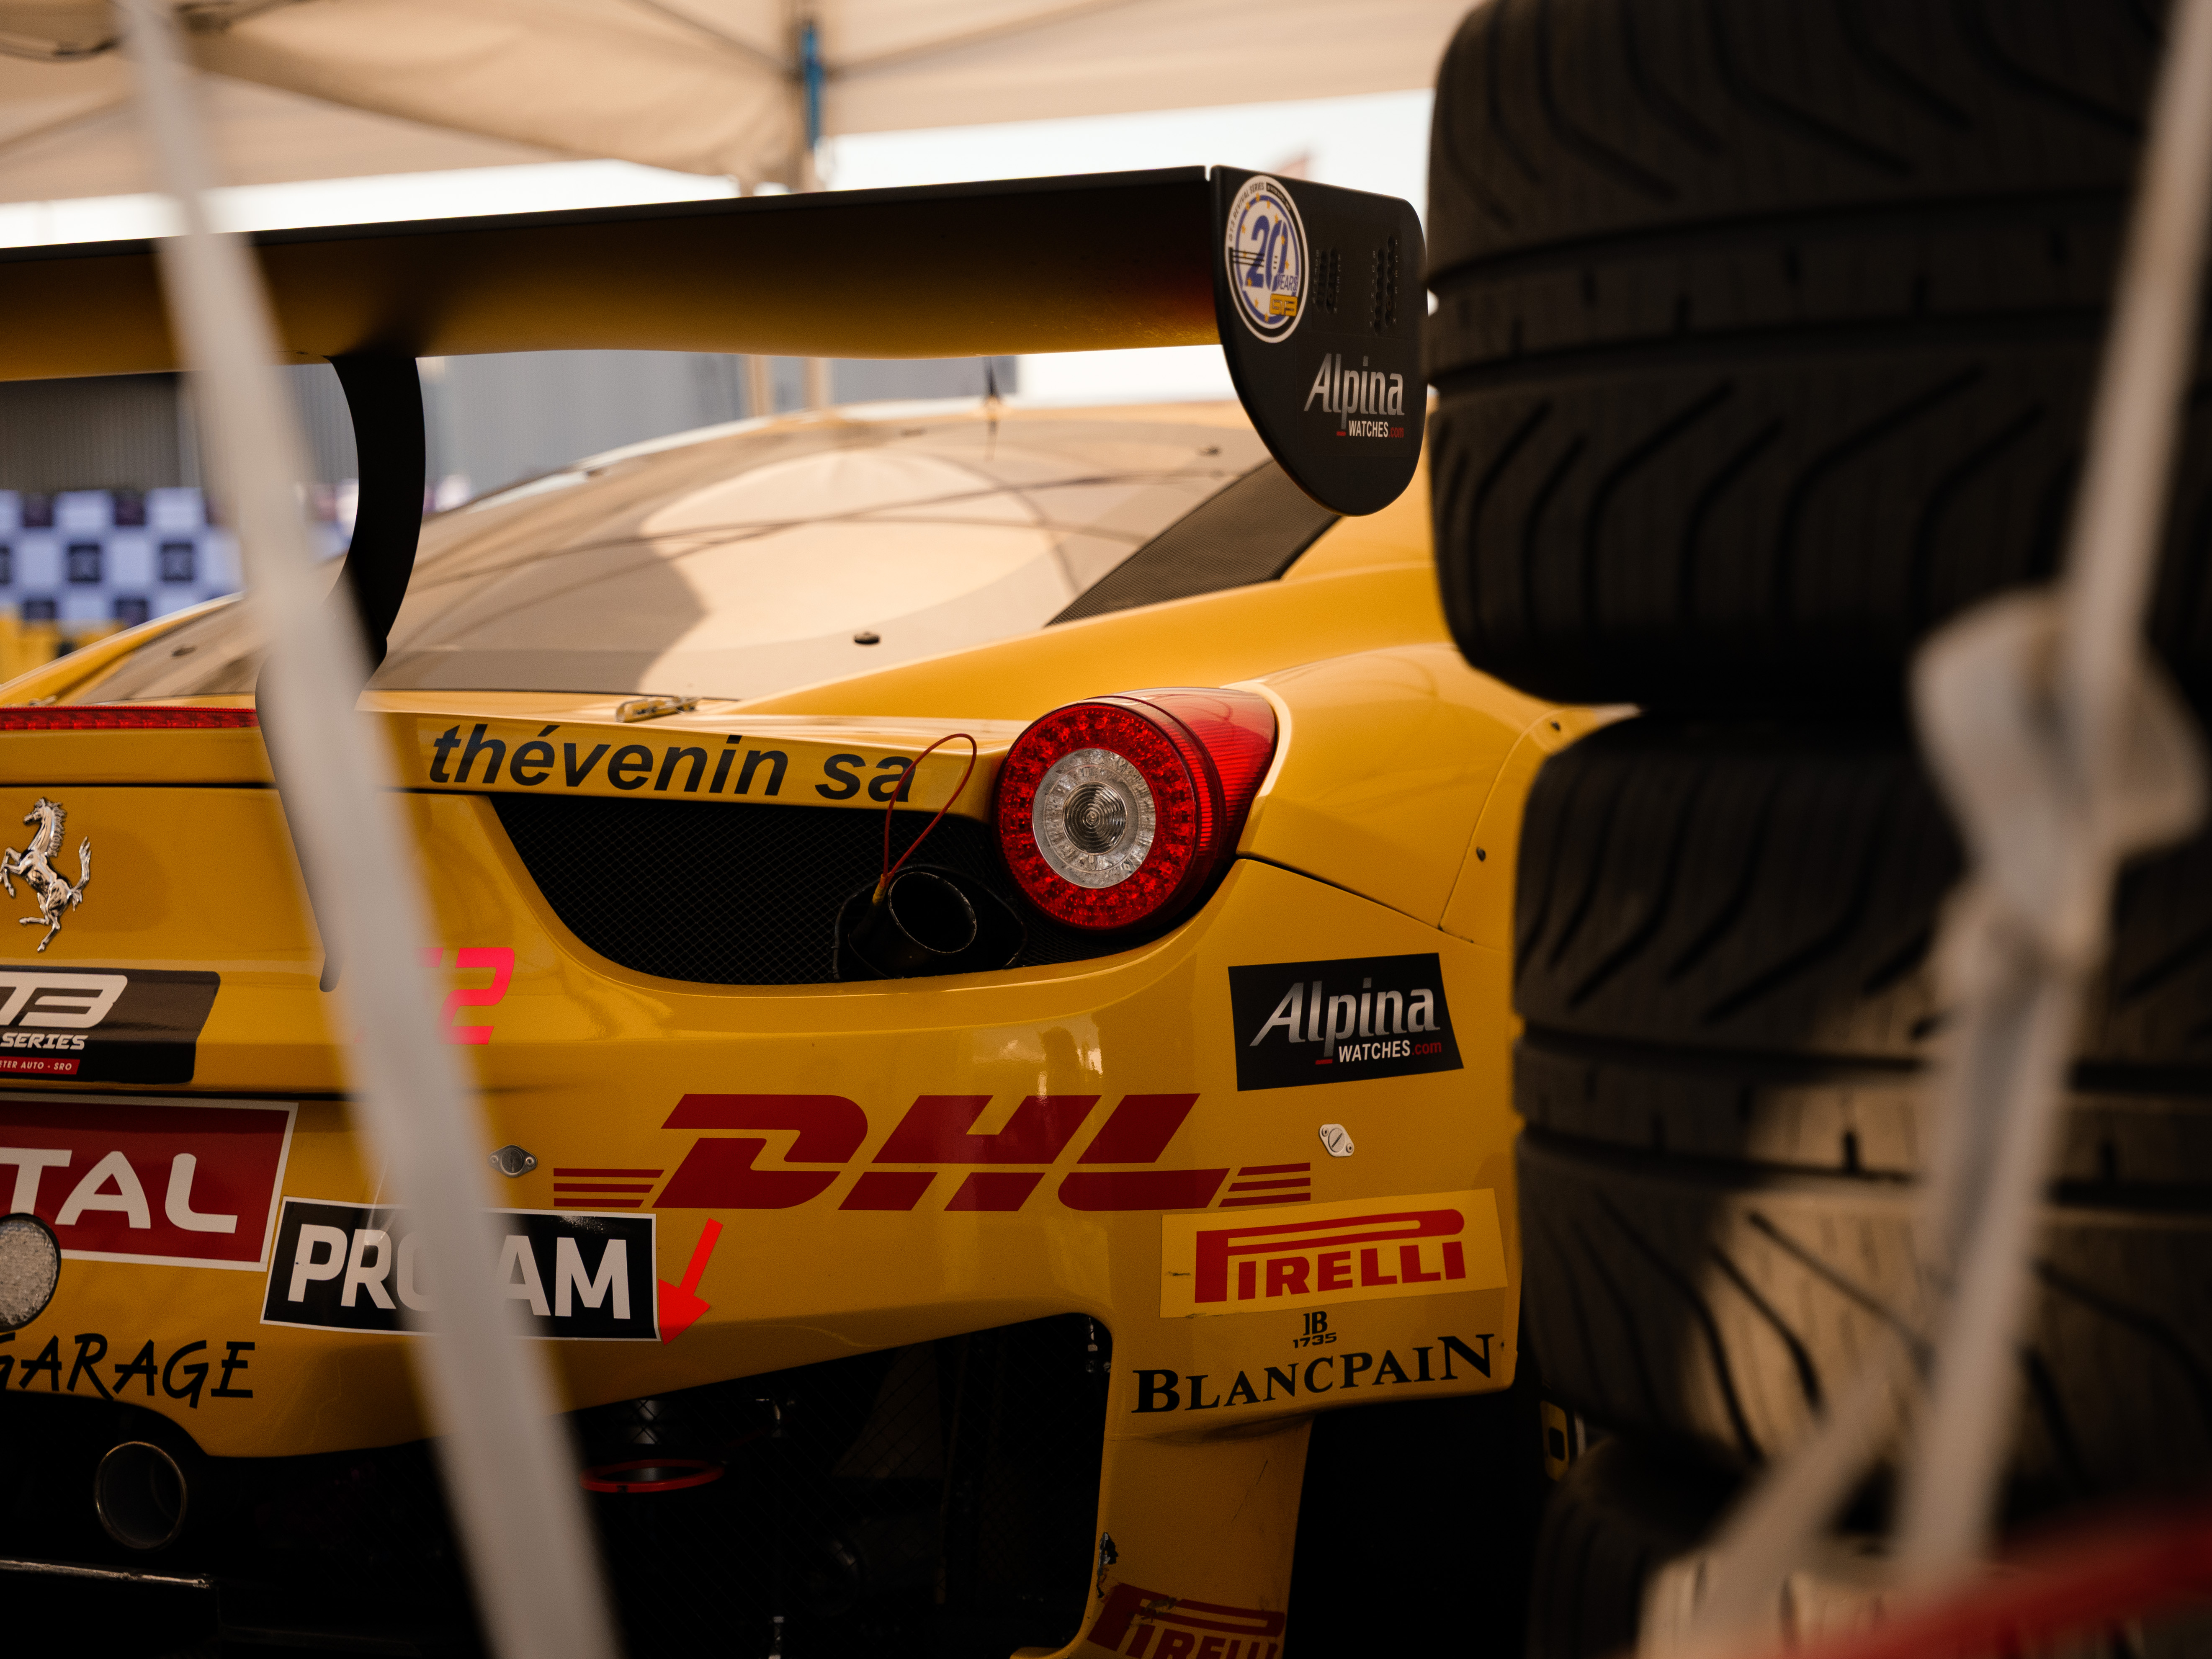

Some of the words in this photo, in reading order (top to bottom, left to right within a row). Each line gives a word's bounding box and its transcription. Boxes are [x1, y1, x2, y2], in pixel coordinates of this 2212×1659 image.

[1233, 189, 1249, 219] REVIVAL
[1249, 182, 1264, 194] SERIES
[1245, 215, 1288, 292] 20
[1276, 274, 1298, 293] YEARS
[1303, 353, 1405, 430] Alpina
[1349, 420, 1404, 438] WATCHES.com
[428, 723, 789, 797] thévenin
[814, 753, 918, 803] sa
[0, 1032, 89, 1050] SERIES
[1249, 977, 1440, 1058] Alpina
[1339, 1040, 1442, 1063] WATCHES.com
[21, 1061, 44, 1070] AUTO
[54, 1062, 72, 1071] SRO
[652, 1093, 1230, 1211] DHL
[489, 1234, 631, 1320] AM
[1194, 1208, 1465, 1304] PIRELLI
[1131, 1333, 1495, 1413] BLANCPAIN
[1293, 1332, 1337, 1348] 1735
